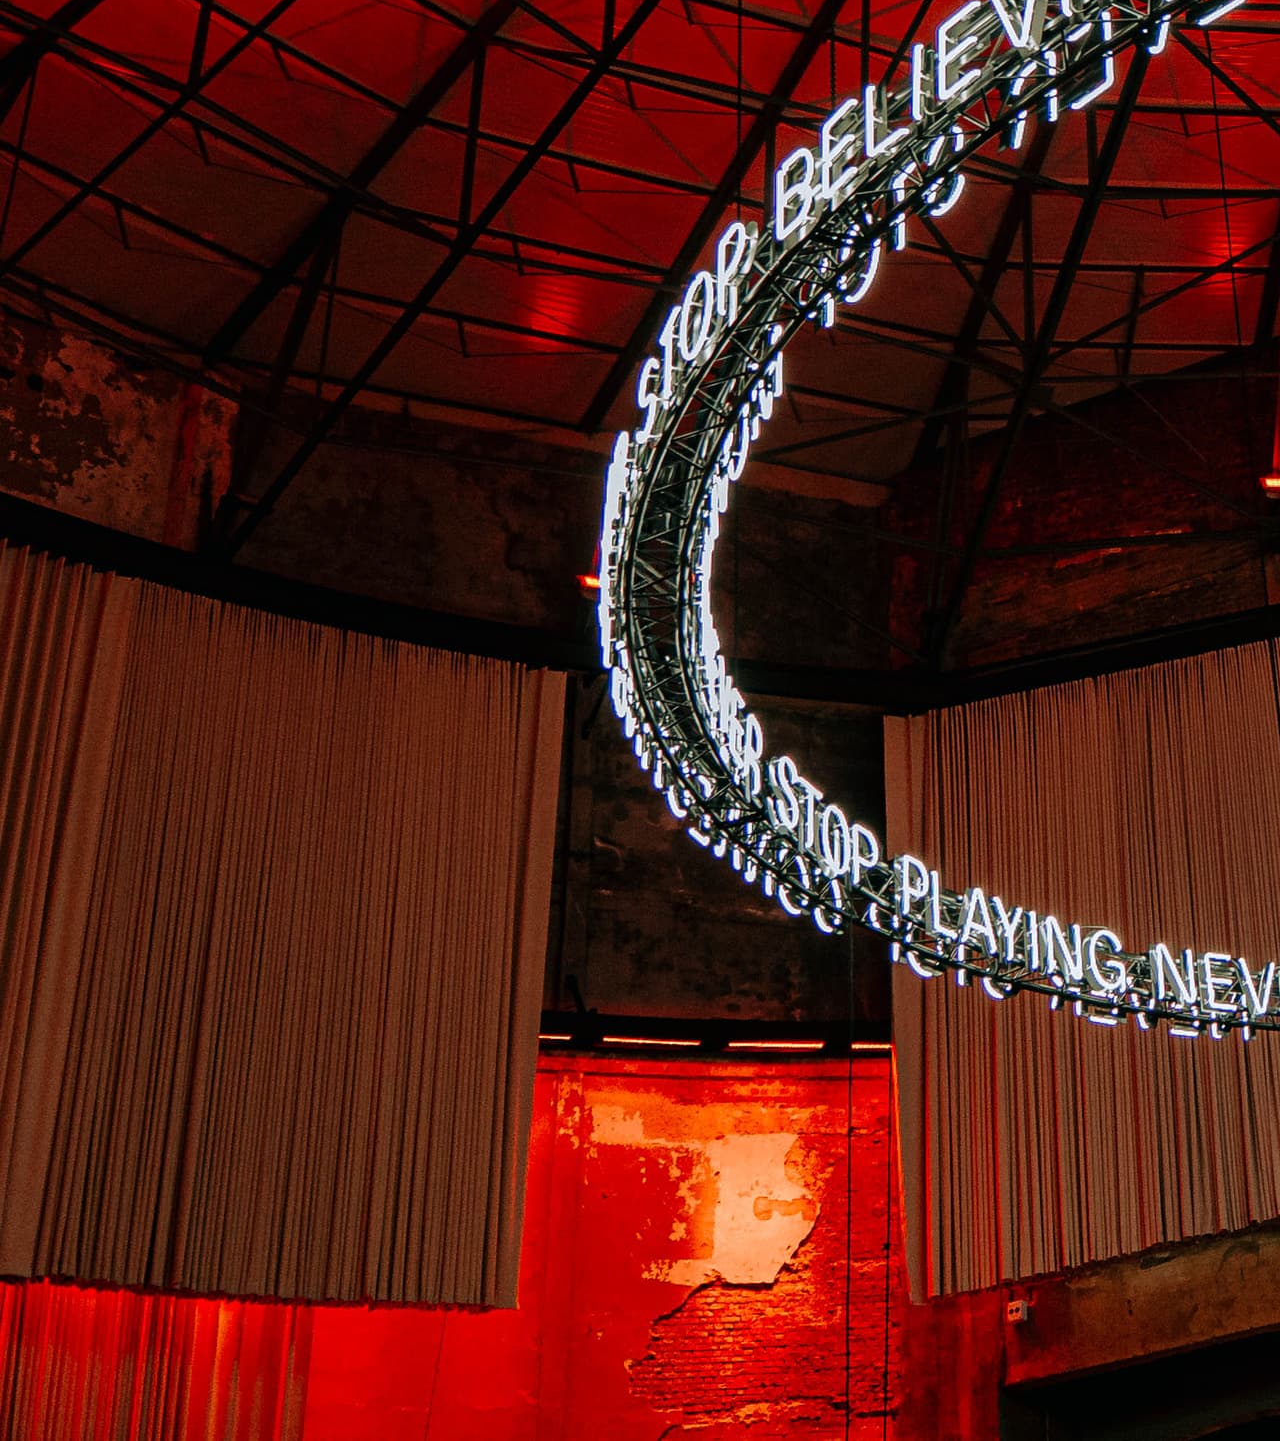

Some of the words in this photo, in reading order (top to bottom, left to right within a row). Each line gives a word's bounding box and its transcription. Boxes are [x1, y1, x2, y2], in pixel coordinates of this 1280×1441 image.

[637, 221, 750, 444] STOP
[768, 756, 879, 887] STOP
[899, 854, 1127, 992] PLAYING
